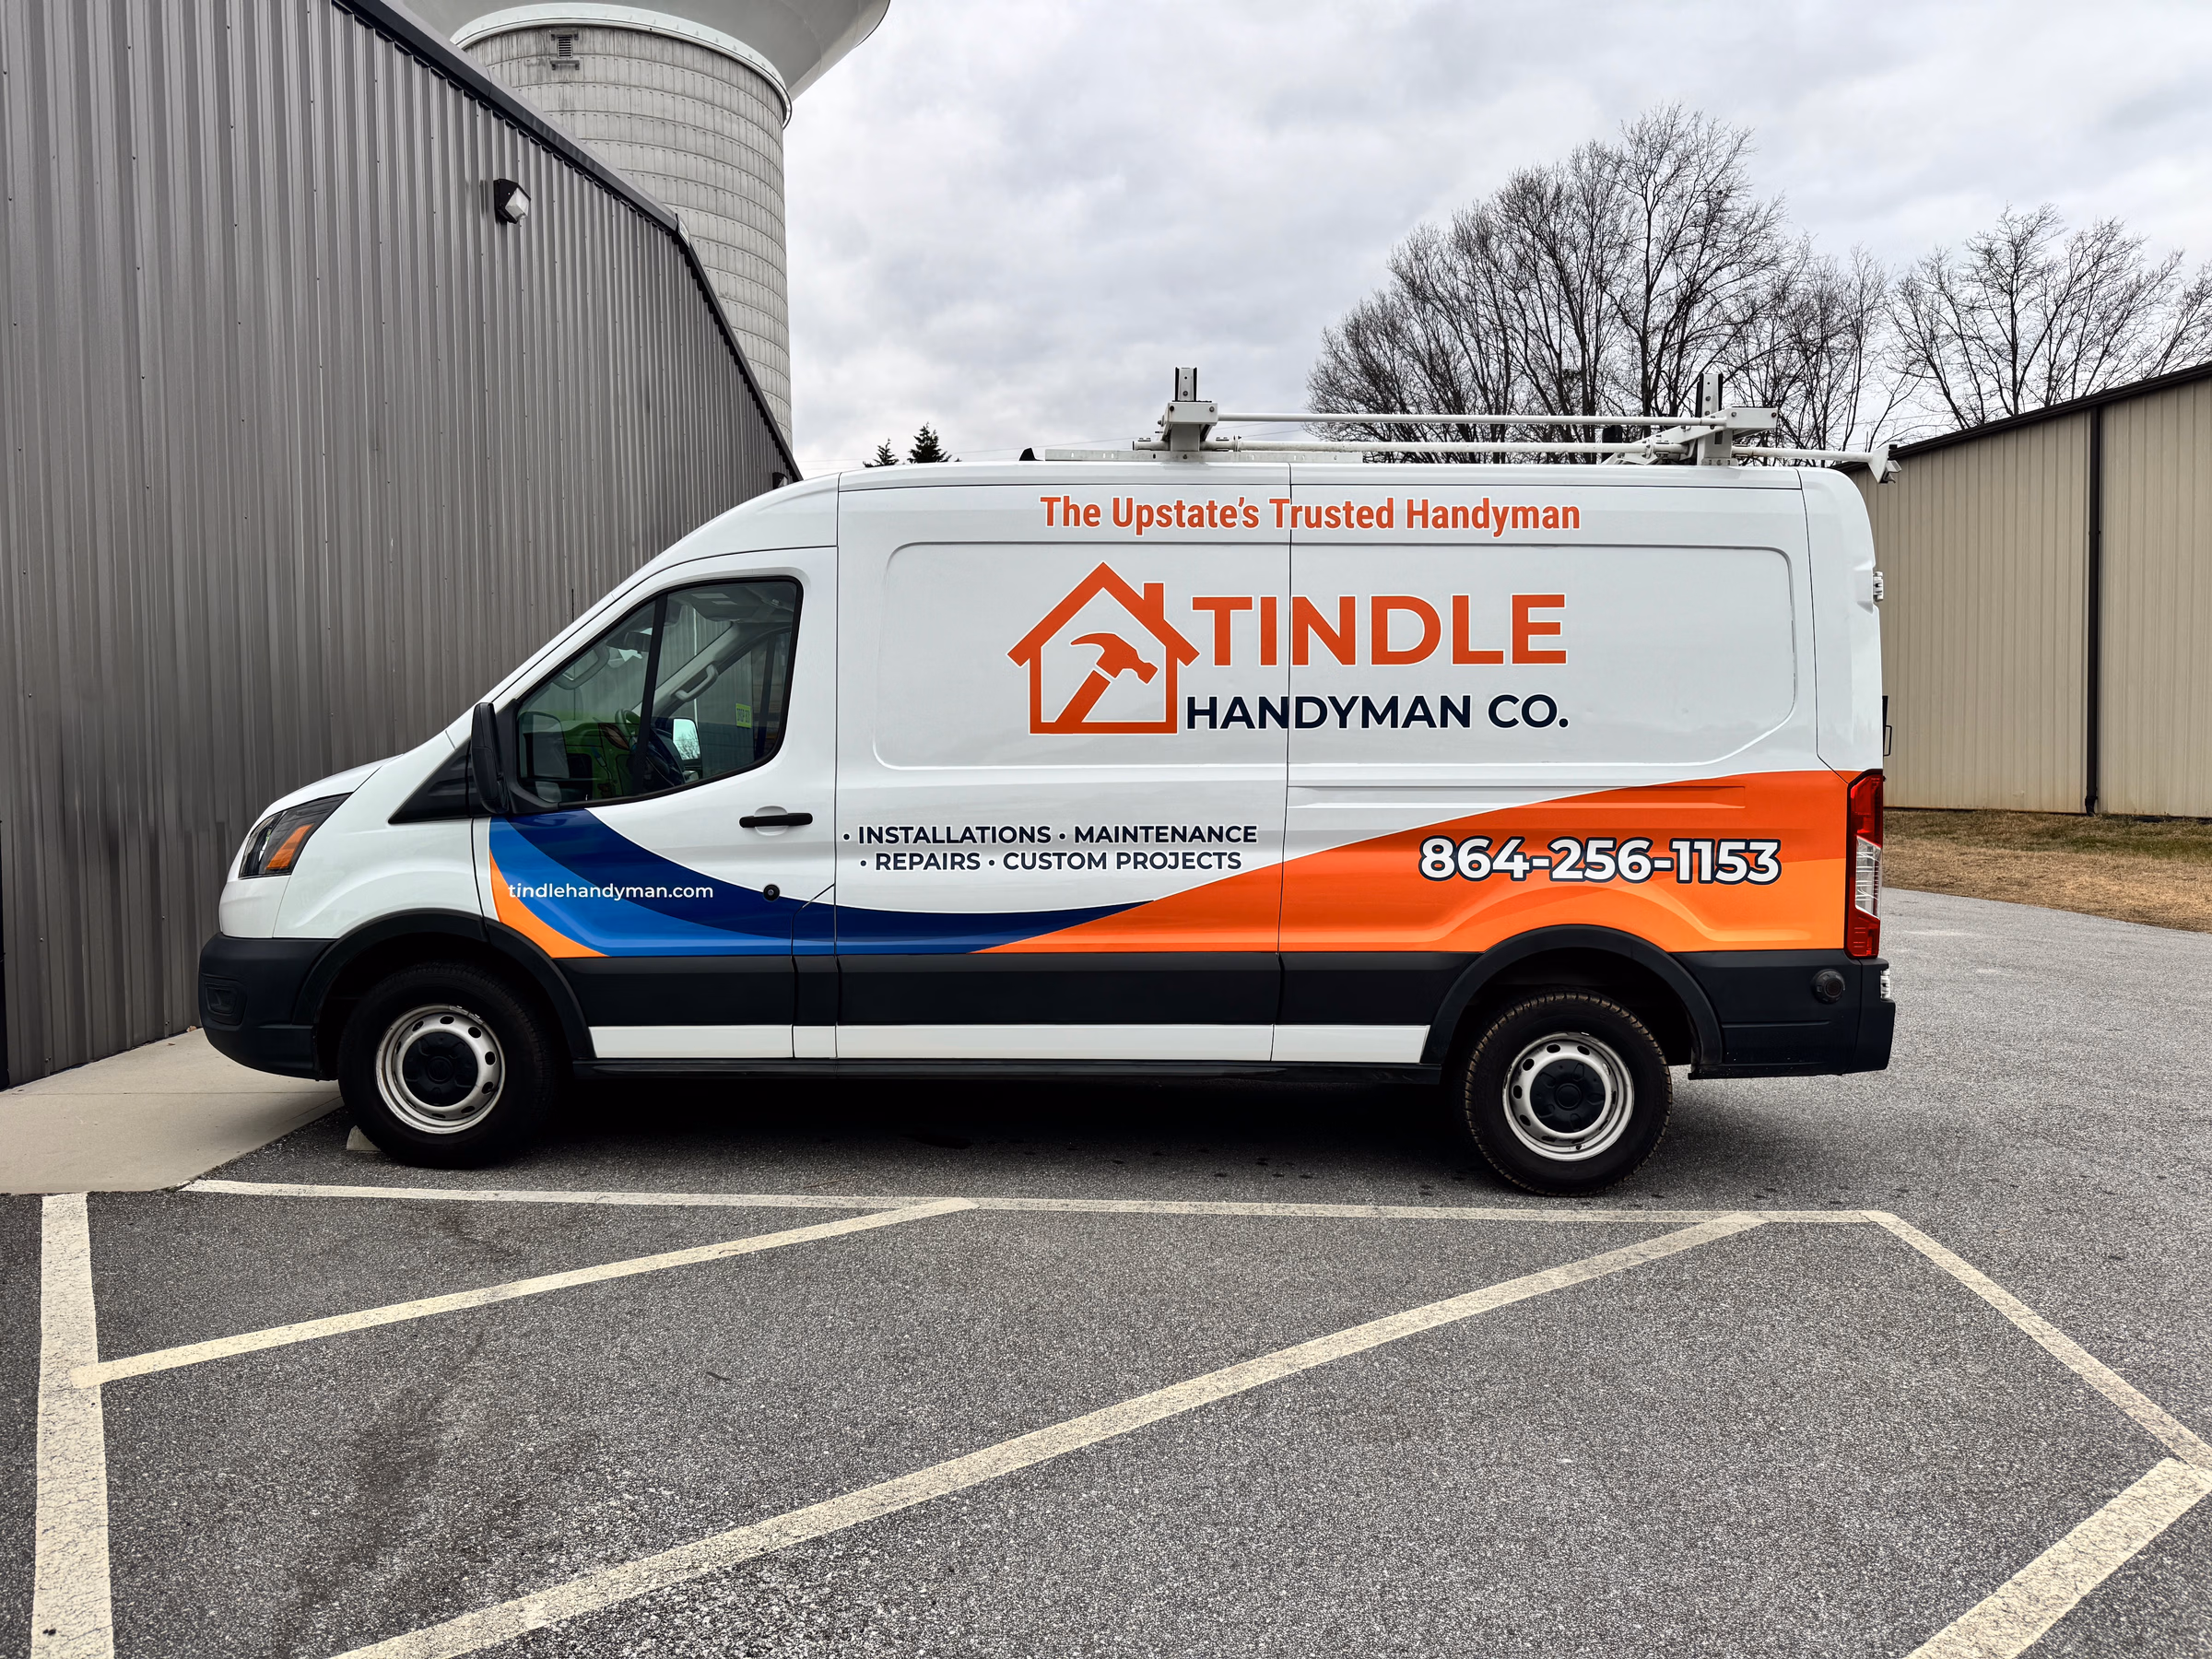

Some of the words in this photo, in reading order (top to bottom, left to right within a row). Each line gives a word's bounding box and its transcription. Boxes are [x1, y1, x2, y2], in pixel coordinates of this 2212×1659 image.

[1040, 496, 1101, 528] The
[1112, 497, 1259, 535] Upstate’s
[1269, 498, 1394, 529] Trusted
[1406, 498, 1580, 537] Handyman
[1193, 594, 1567, 665] TINDLE
[1188, 696, 1471, 729] HANDYMAN
[1488, 695, 1569, 728] CO.
[858, 825, 1052, 844] INSTALLATIONS
[1075, 825, 1257, 843] MAINTENANCE
[876, 853, 981, 871] REPAIRS
[1003, 852, 1107, 870] CUSTOM
[1116, 852, 1241, 870] PROJECTS
[1420, 836, 1780, 883] 864-256-1153
[508, 883, 713, 900] tindlehandyman.com
